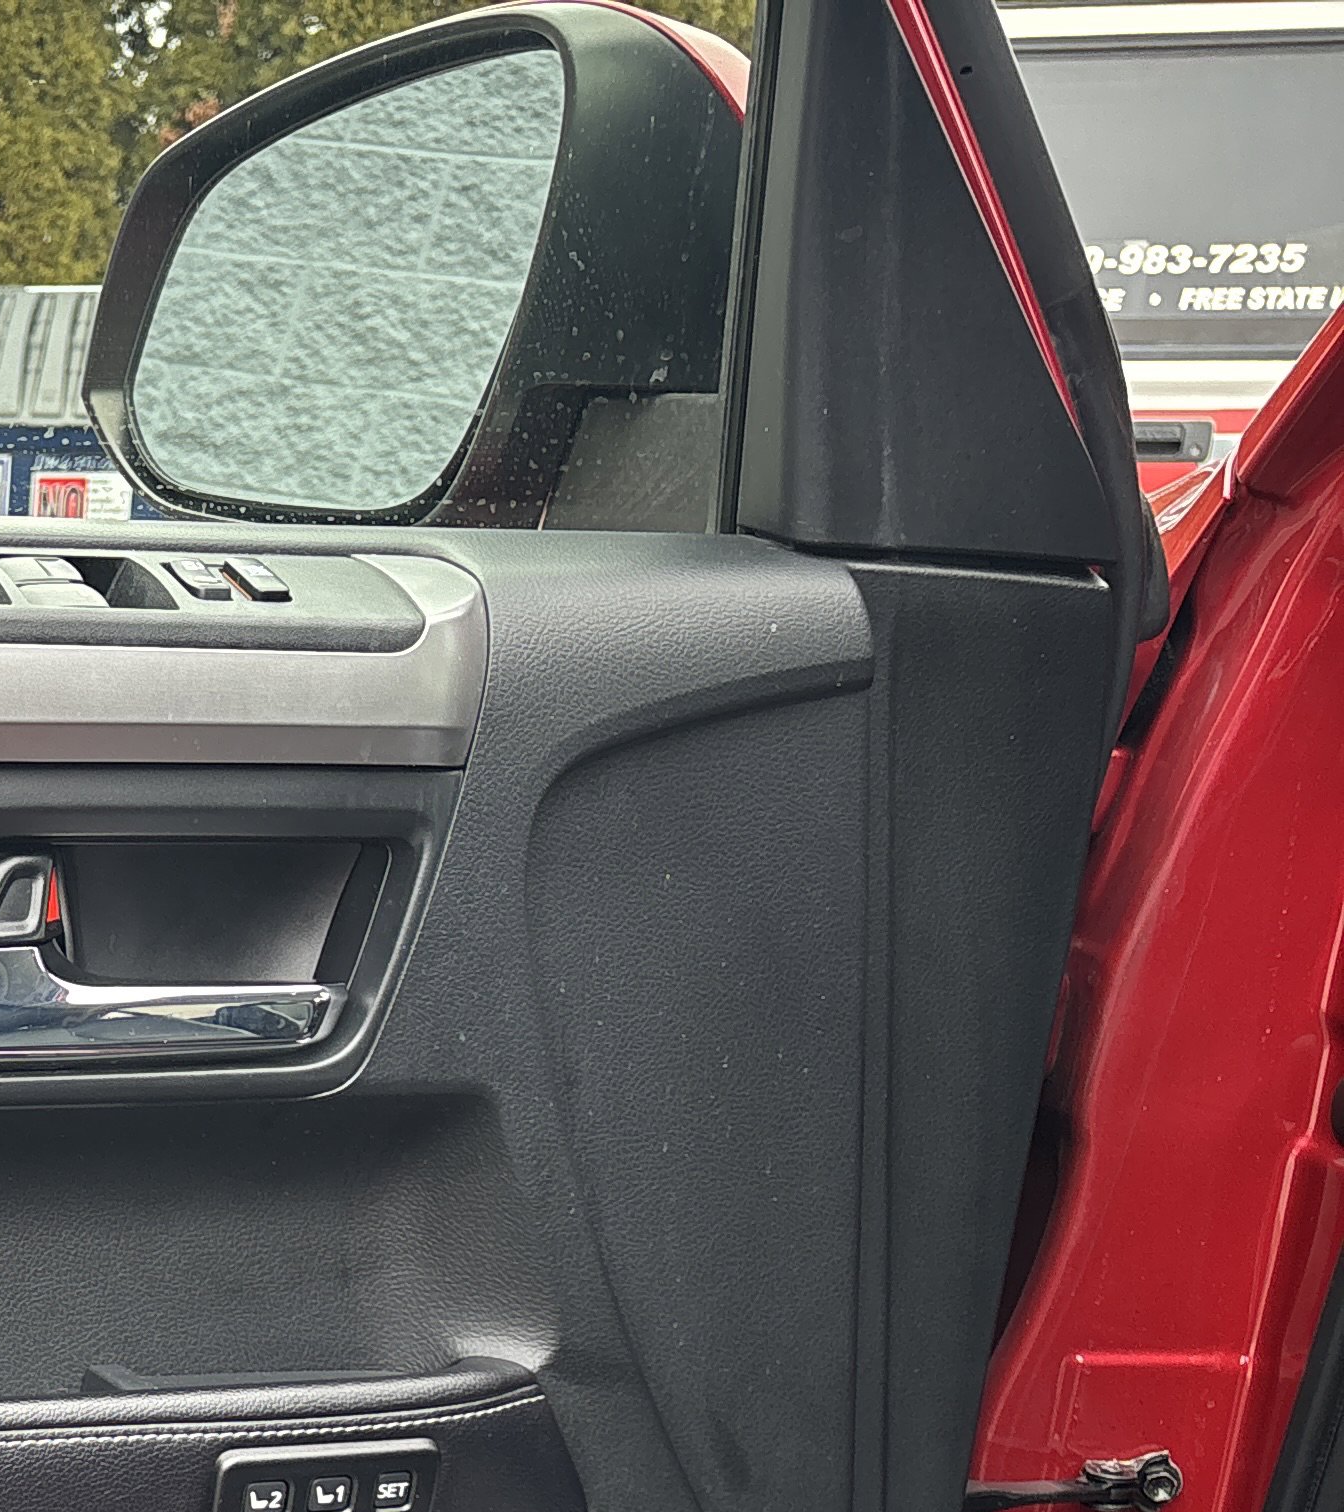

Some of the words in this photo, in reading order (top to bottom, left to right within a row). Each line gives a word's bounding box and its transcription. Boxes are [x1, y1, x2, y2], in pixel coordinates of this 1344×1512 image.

[1178, 286, 1246, 310] FREE
[1247, 286, 1328, 310] STATE
[376, 1482, 410, 1499] SET
